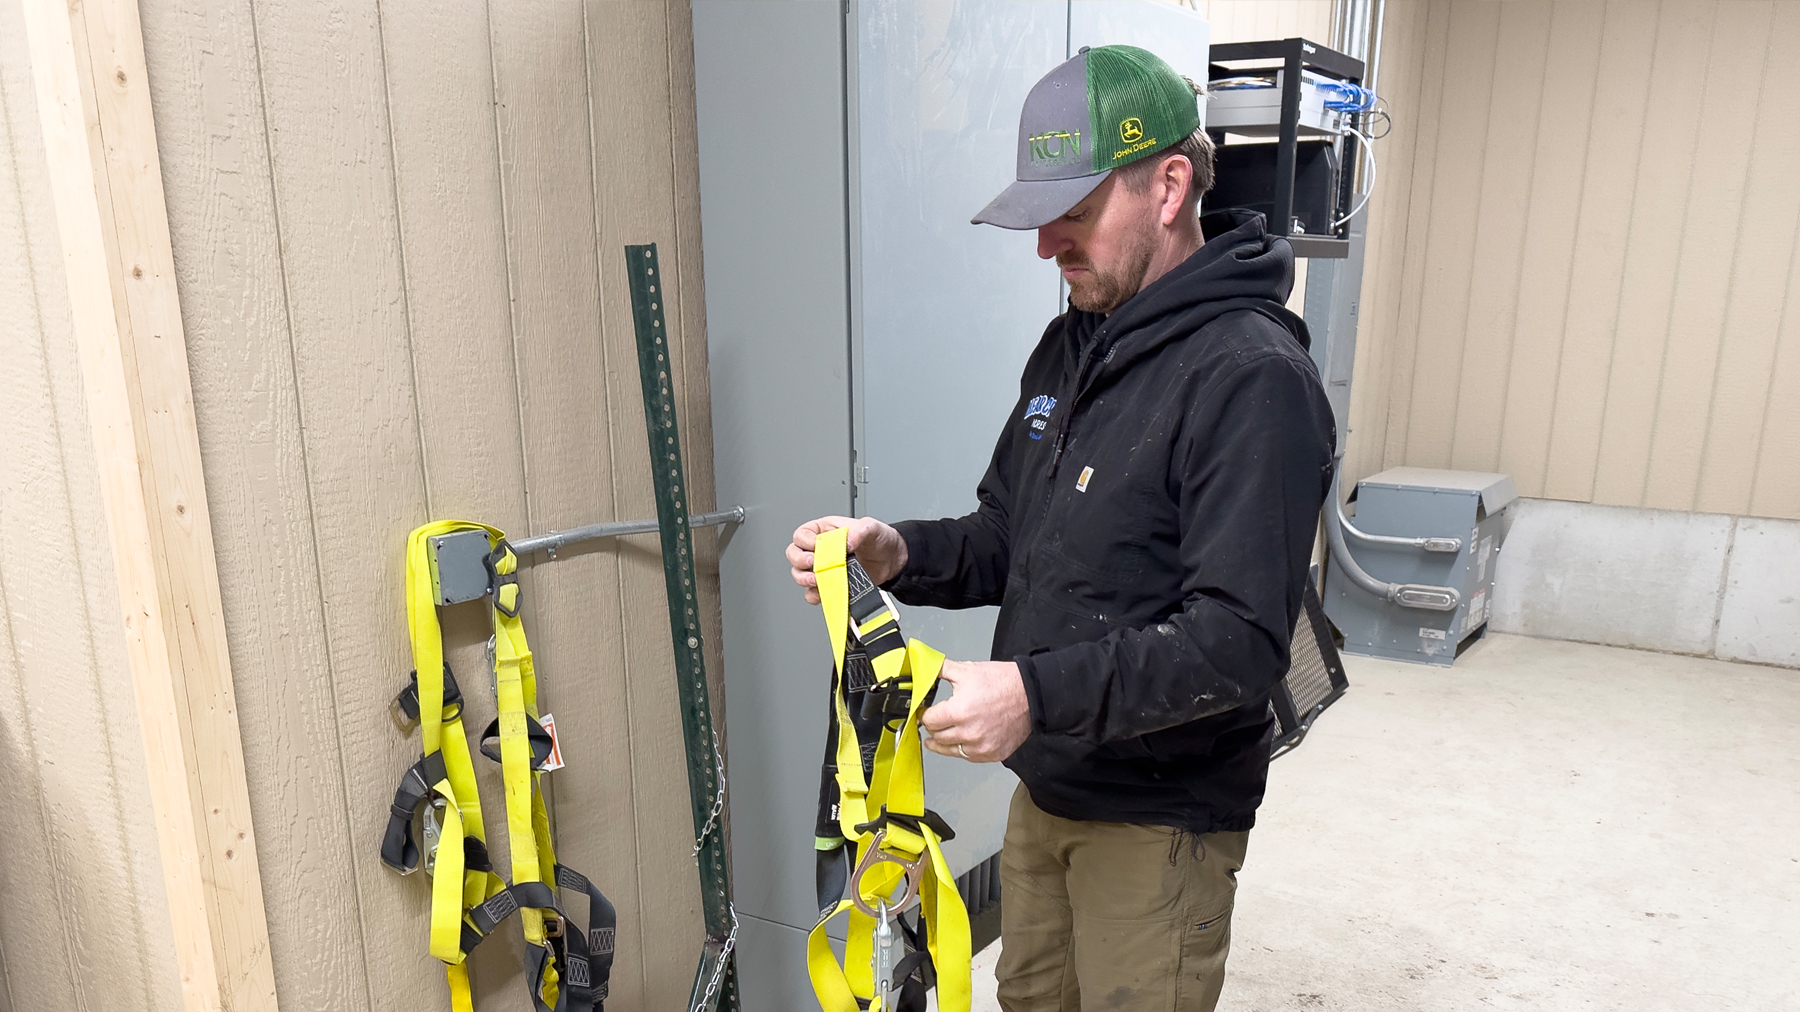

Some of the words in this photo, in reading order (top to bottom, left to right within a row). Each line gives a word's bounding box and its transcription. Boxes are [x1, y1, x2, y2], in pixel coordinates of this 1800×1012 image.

[1029, 128, 1081, 161] KCN
[1113, 147, 1132, 159] JOHN
[1132, 138, 1156, 151] DEERE
